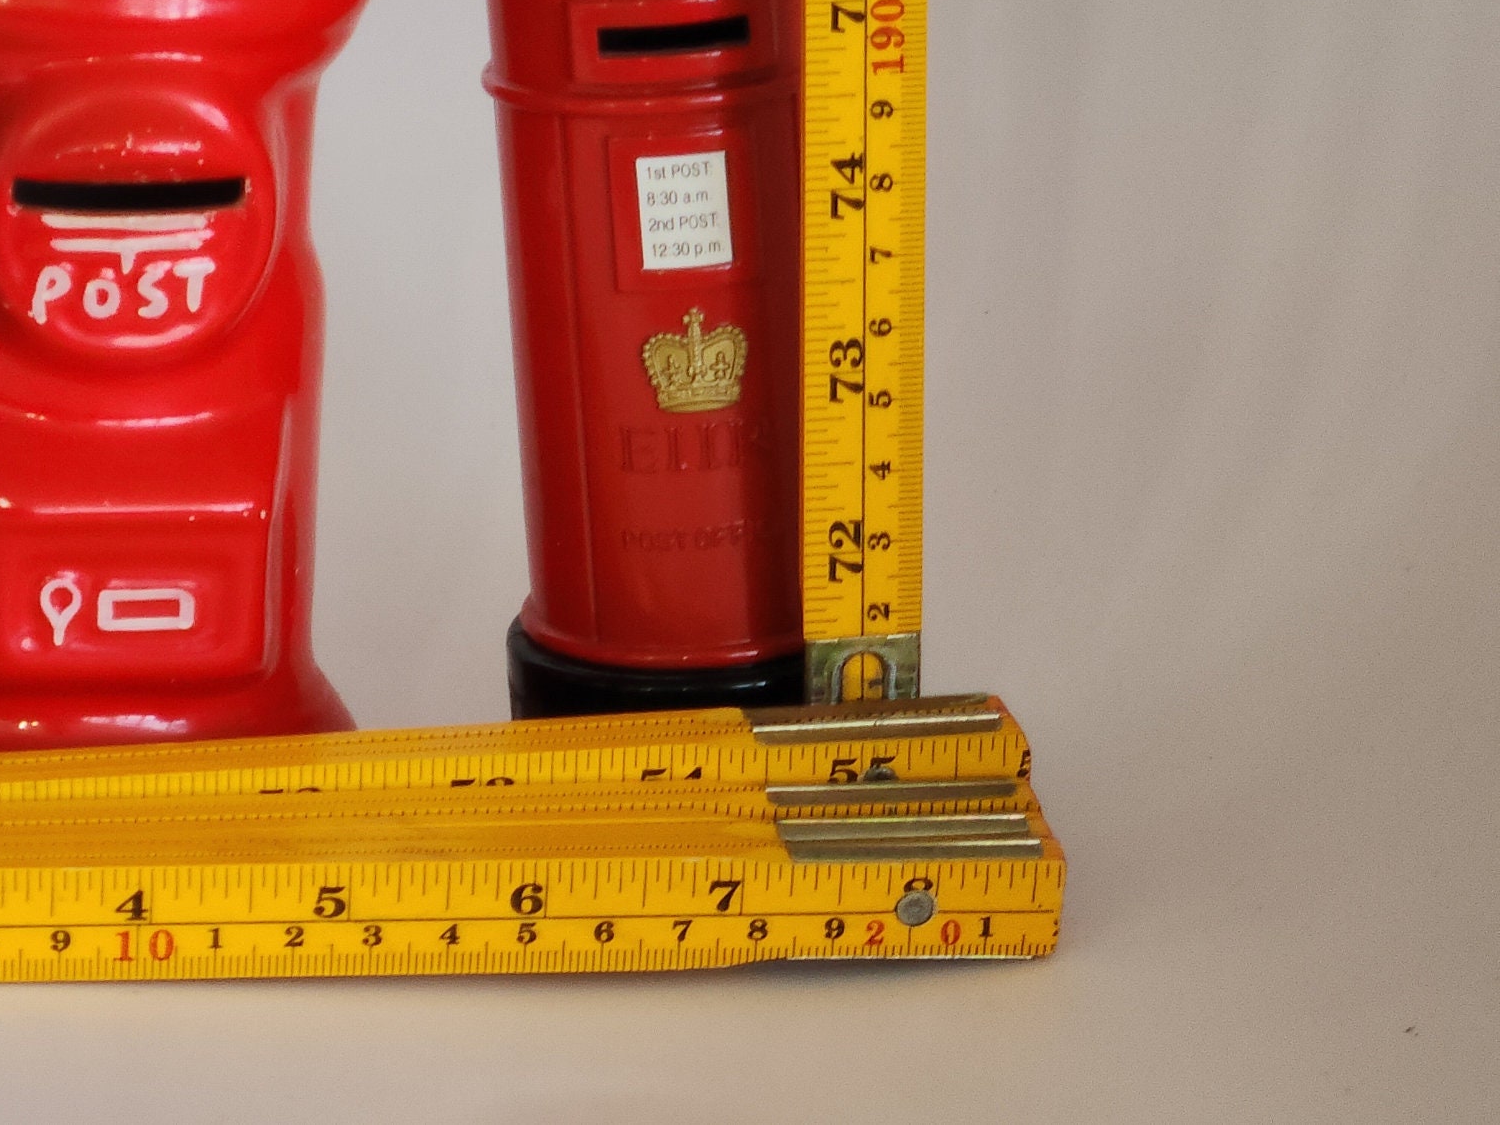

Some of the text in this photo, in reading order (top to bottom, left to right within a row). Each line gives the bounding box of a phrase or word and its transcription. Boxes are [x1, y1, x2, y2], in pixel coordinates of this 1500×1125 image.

[647, 166, 666, 180] 1st
[870, 173, 894, 193] 8
[830, 151, 865, 220] 74
[648, 217, 674, 233] 2nd
[869, 246, 893, 265] 7
[27, 256, 216, 325] POST
[868, 317, 893, 338] 6
[829, 337, 865, 404] 73
[868, 388, 893, 409] 5
[869, 460, 891, 481] 4
[828, 518, 864, 584] 72
[868, 531, 891, 551] 3
[867, 602, 890, 622] 2
[114, 890, 149, 922] 4
[313, 885, 347, 920] 5
[510, 882, 544, 916] 6
[707, 880, 741, 912] 7
[50, 930, 71, 953] 9
[208, 928, 224, 949] 1
[284, 926, 305, 948] 2
[362, 925, 383, 946] 3
[439, 923, 460, 945] 4
[517, 922, 537, 944] 5
[594, 921, 615, 943] 6
[672, 920, 693, 941] 7
[747, 919, 768, 941] 8
[825, 916, 845, 939] 9
[980, 916, 993, 938] 1
